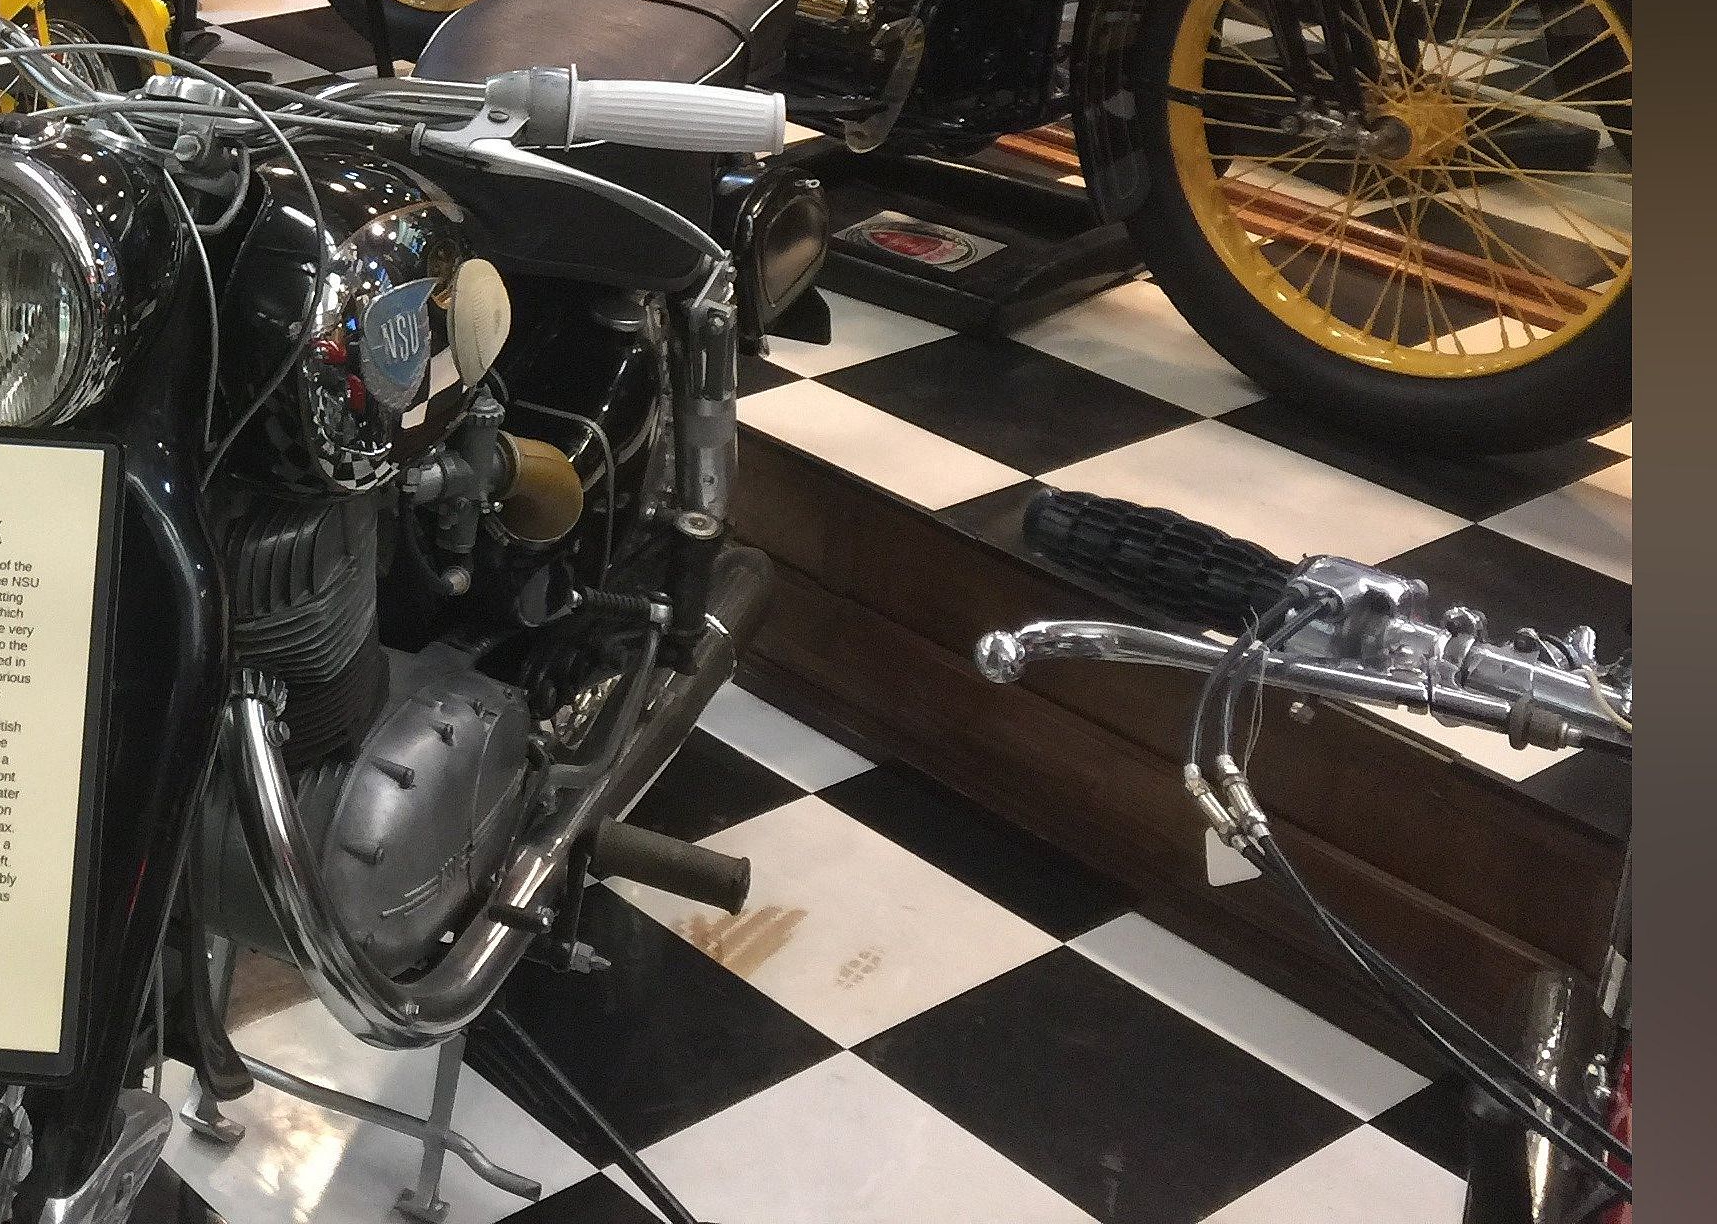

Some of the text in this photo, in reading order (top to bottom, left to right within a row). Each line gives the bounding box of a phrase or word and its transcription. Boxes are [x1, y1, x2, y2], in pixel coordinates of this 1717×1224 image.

[380, 312, 420, 363] NSU
[10, 575, 41, 590] NSU
[7, 624, 36, 639] very
